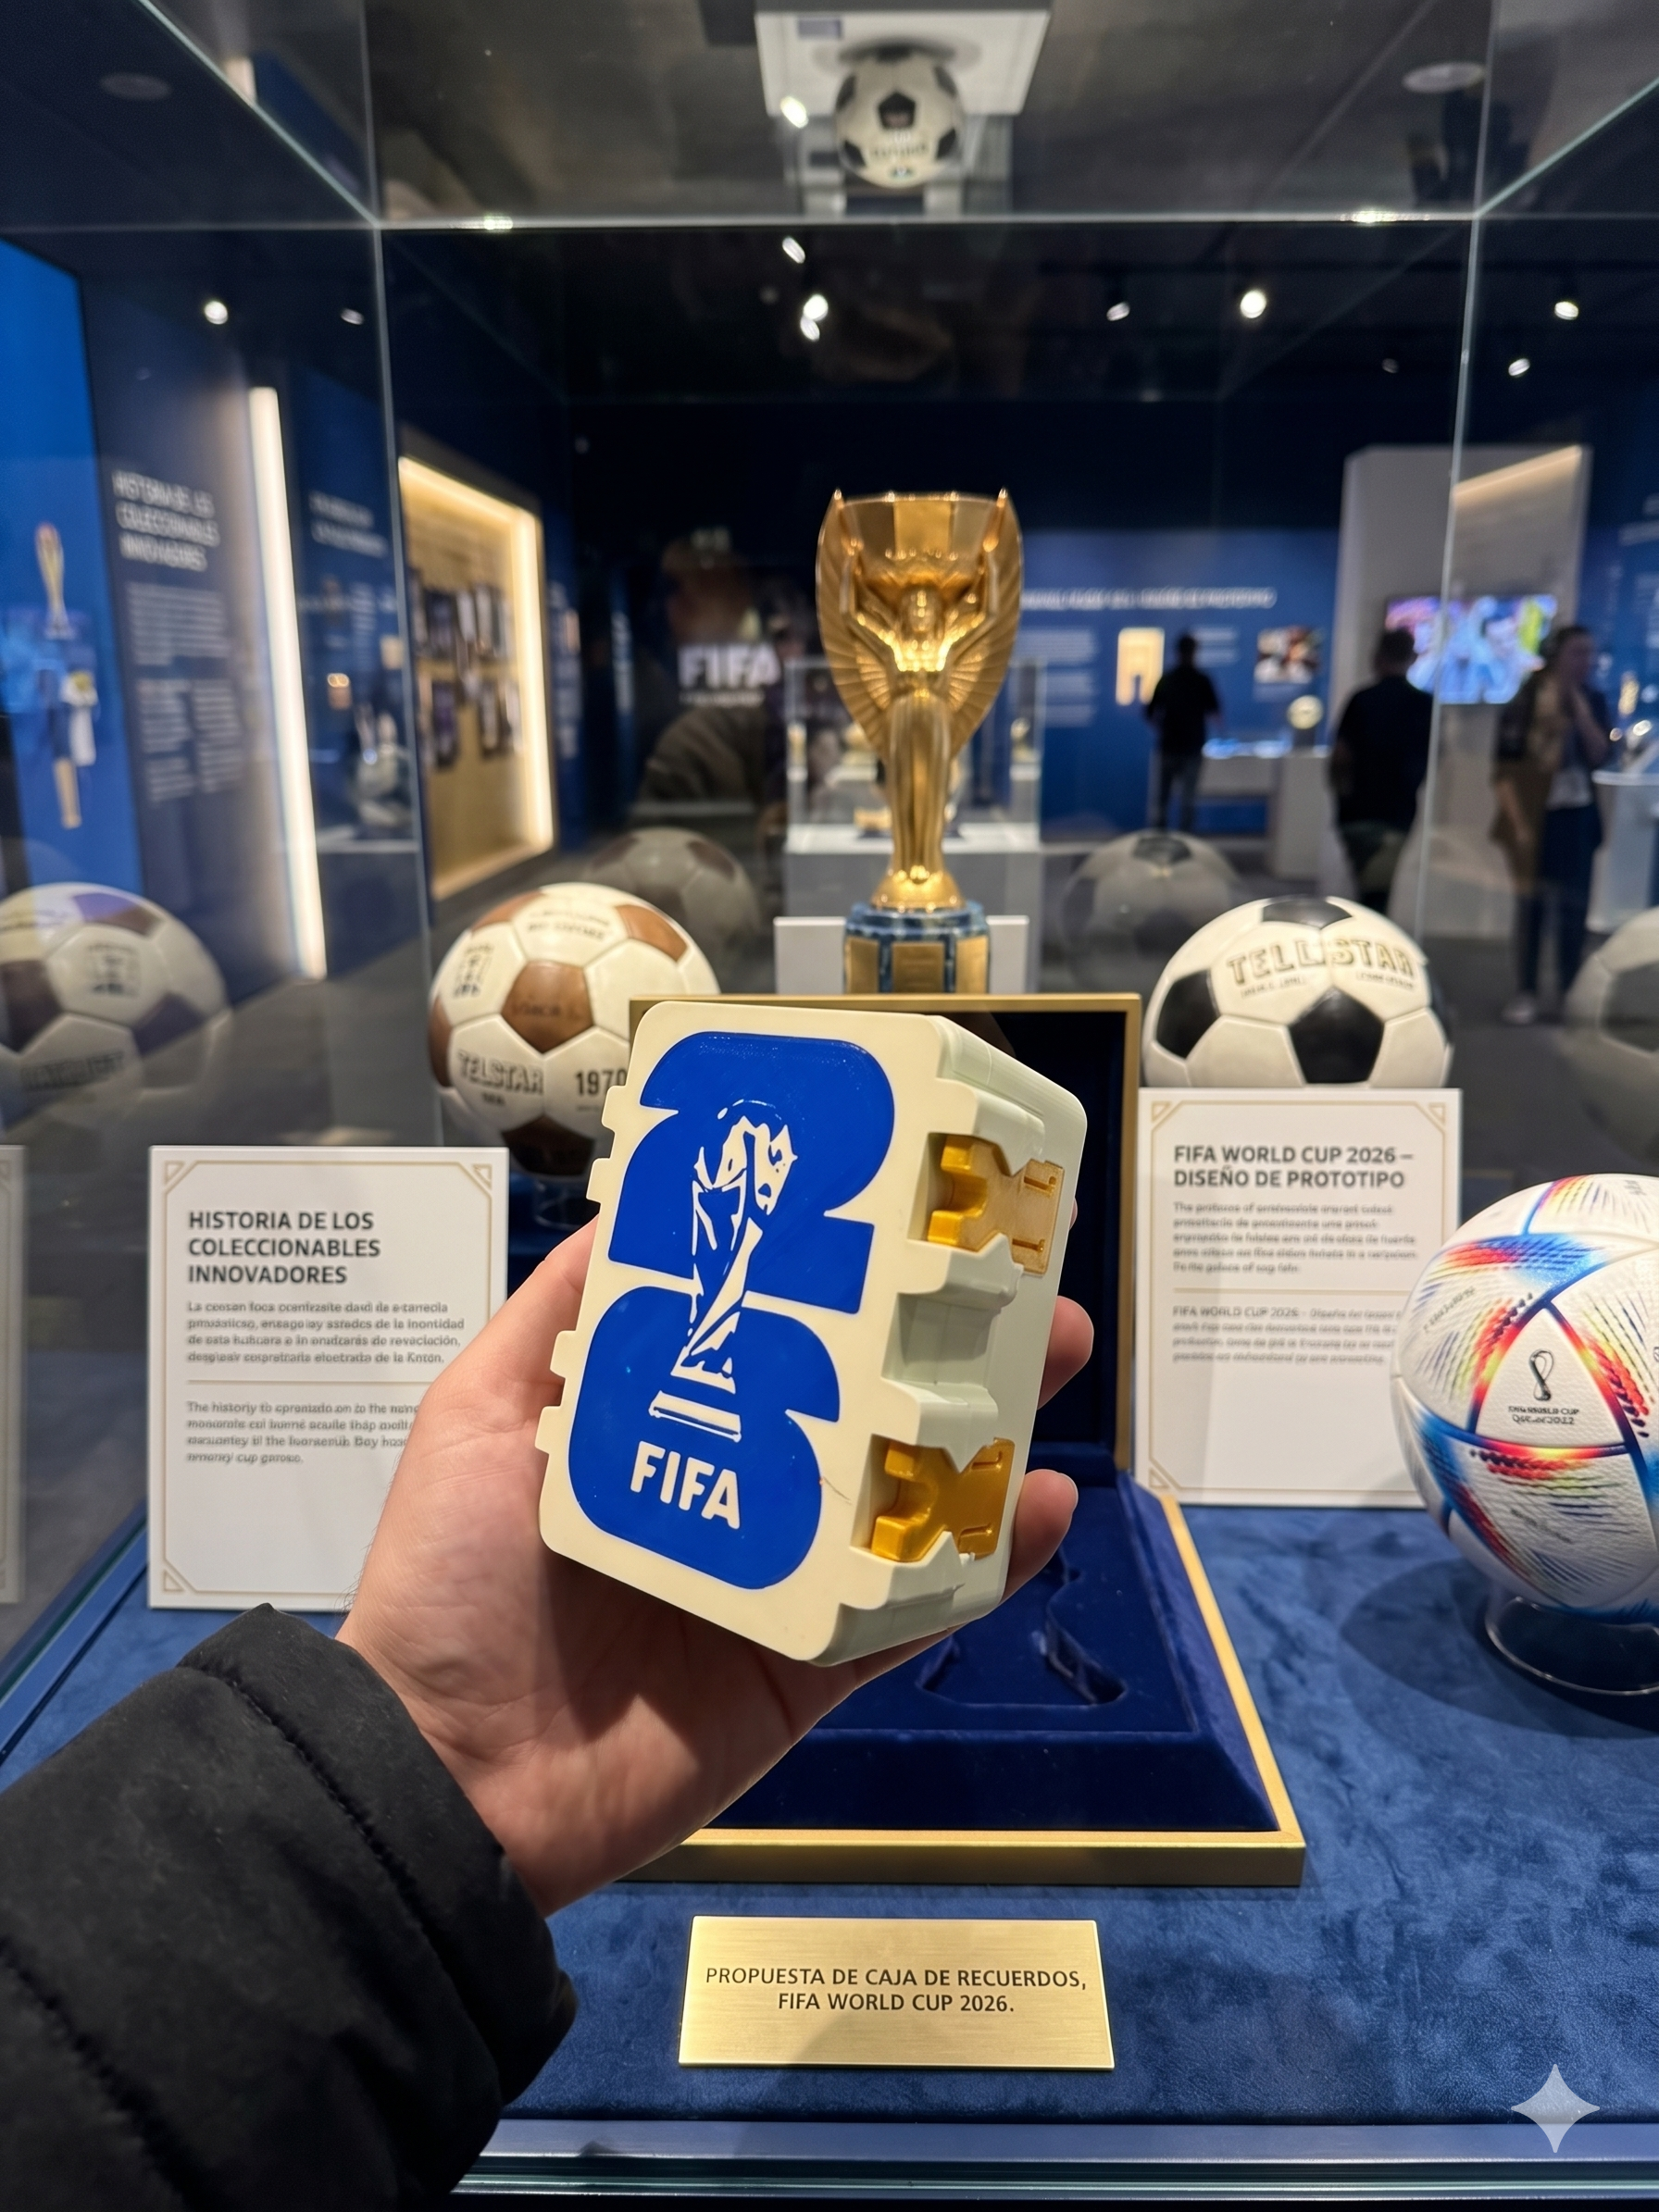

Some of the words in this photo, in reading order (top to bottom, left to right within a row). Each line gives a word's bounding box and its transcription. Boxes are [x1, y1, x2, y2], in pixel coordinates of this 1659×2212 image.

[678, 643, 781, 688] FIFA
[1174, 1145, 1216, 1163] FIFA
[1221, 1146, 1296, 1163] WORLD
[1301, 1146, 1341, 1163] CUP
[1346, 1146, 1397, 1164] 2026
[1174, 1164, 1249, 1187] DISEÑO
[1254, 1170, 1281, 1187] DE
[1287, 1170, 1404, 1188] PROTOTIPO
[189, 1212, 292, 1230] HISTORIA
[298, 1212, 327, 1230] DE
[333, 1212, 374, 1231] LOS
[188, 1238, 380, 1258] COLECCIONABLES
[188, 1264, 348, 1285] INNOVADORES
[1173, 1306, 1197, 1318] FIFA
[630, 1441, 742, 1530] FIFA
[706, 1968, 825, 1985] PROPUESTA
[832, 1969, 858, 1985] DE
[866, 1969, 917, 1986] CAJA
[924, 1970, 951, 1986] DE
[957, 1970, 1087, 1990] RECUERDOS,
[779, 1993, 820, 2009] FIFA
[828, 1994, 904, 2010] WORLD
[912, 1995, 954, 2011] CUP
[960, 1995, 1016, 2012] 2026.
